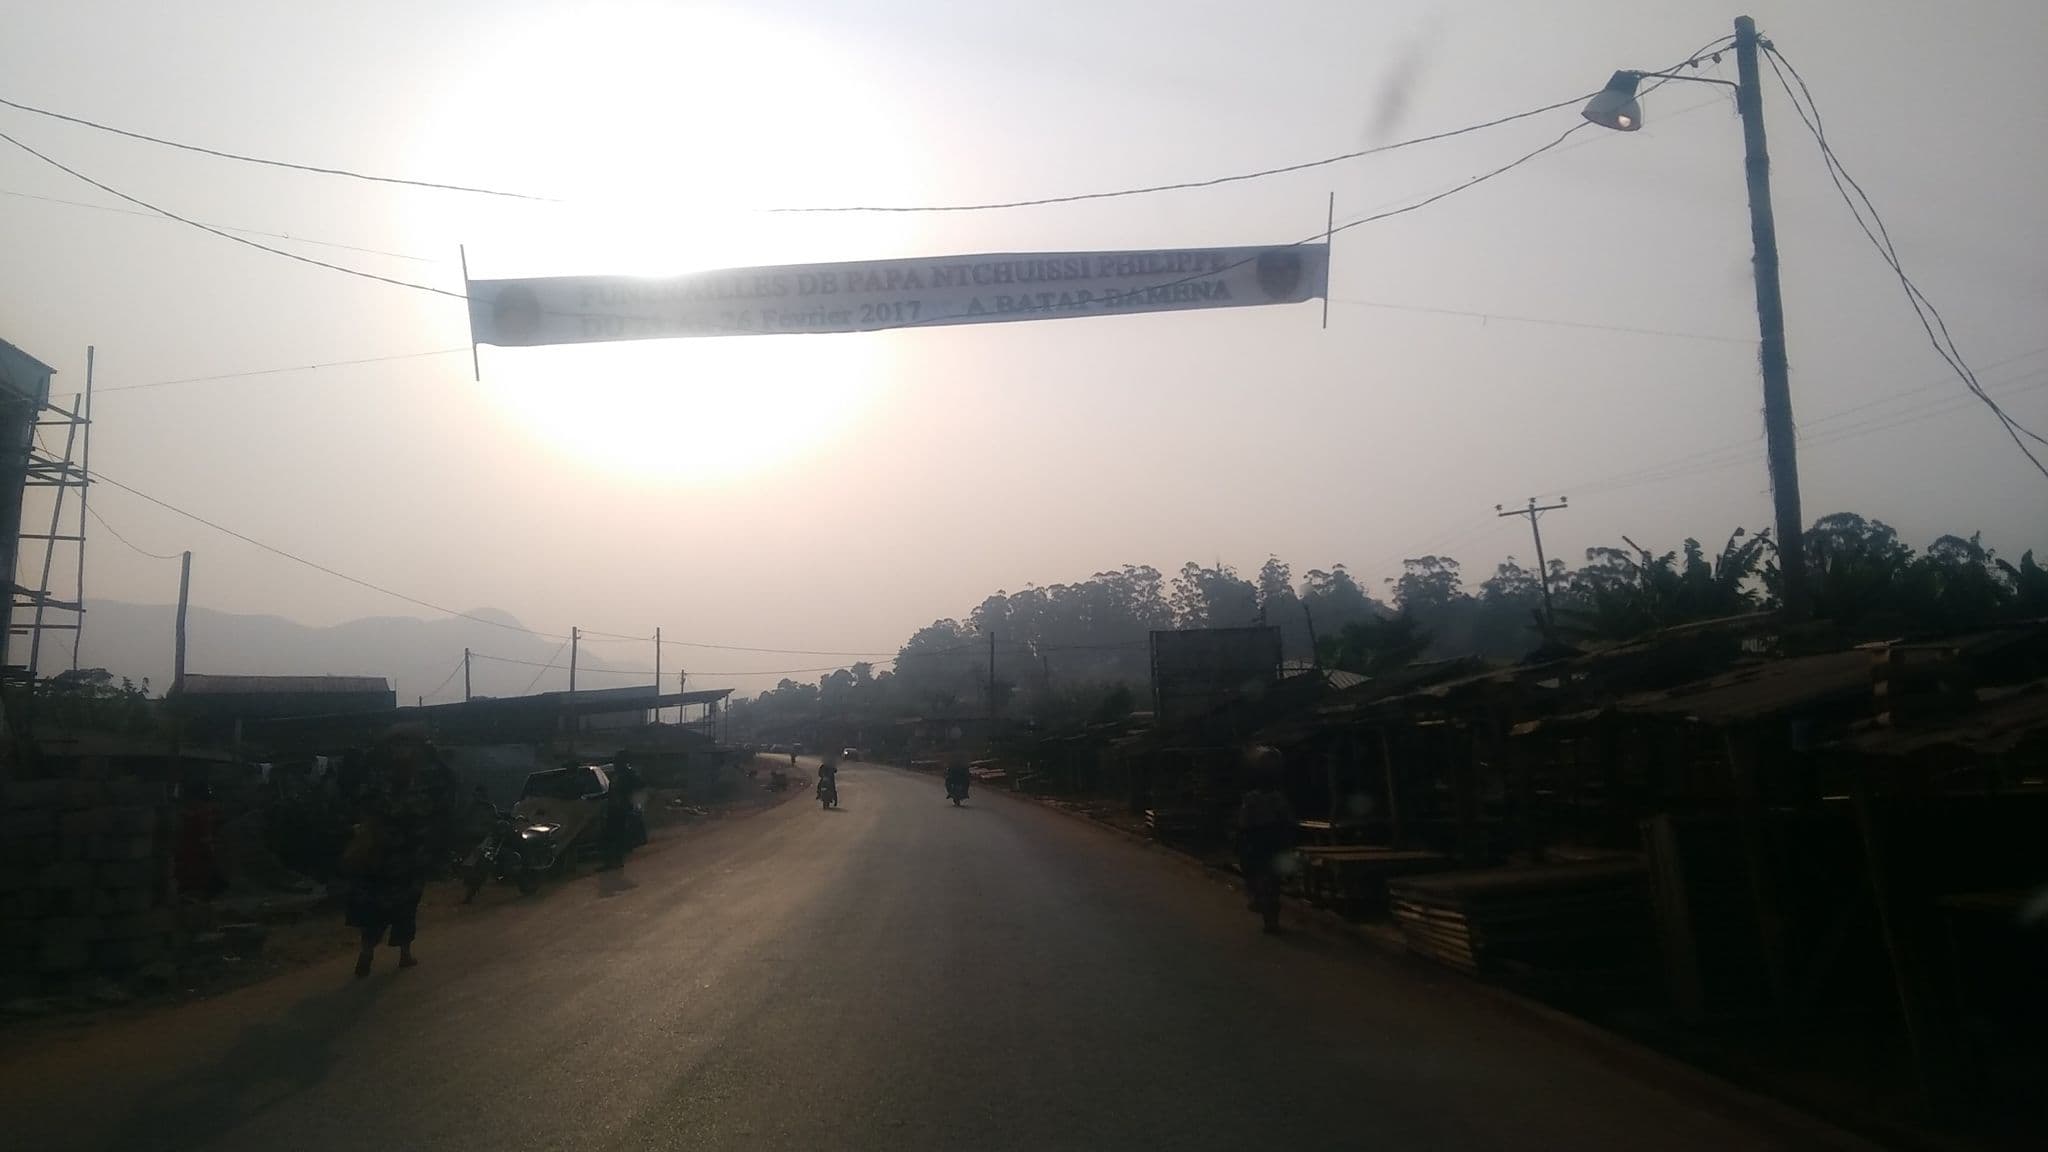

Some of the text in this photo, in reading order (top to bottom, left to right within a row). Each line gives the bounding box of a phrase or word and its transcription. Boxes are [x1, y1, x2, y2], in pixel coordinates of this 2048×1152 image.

[797, 272, 837, 297] DE
[845, 266, 926, 292] PAPA
[929, 256, 1092, 289] NTCHUISSI
[859, 301, 922, 324] 2017
